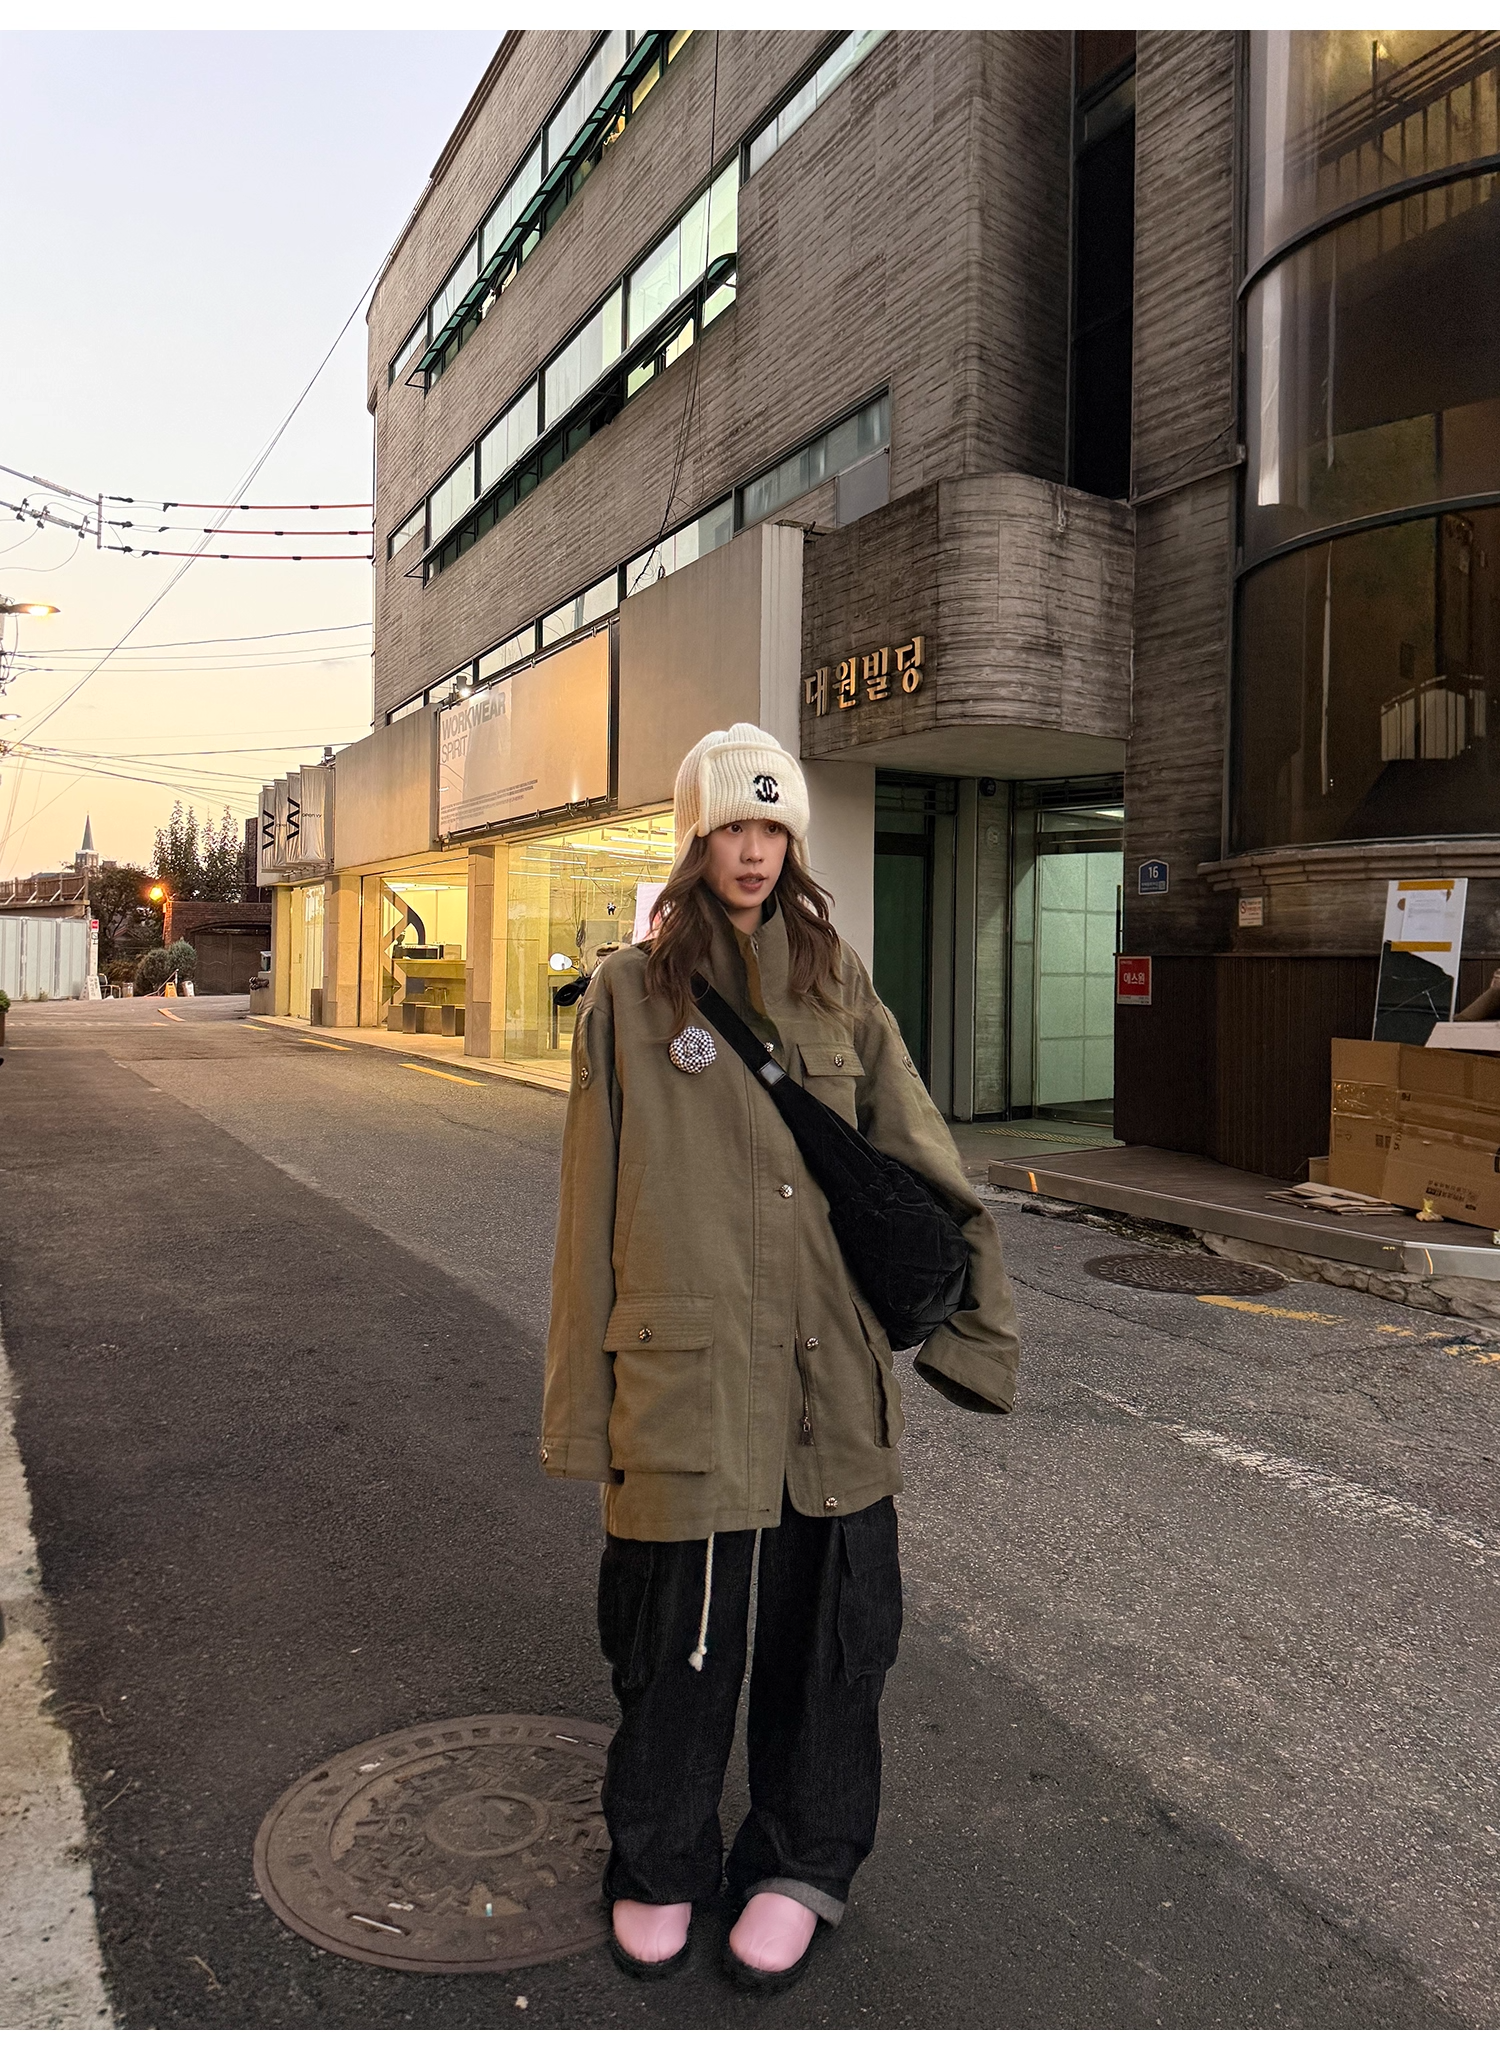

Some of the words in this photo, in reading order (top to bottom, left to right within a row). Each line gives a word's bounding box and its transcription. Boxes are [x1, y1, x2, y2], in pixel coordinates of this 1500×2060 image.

[803, 635, 926, 717] 대원빌딩
[442, 692, 506, 741] WORKWEAR
[441, 734, 468, 763] SPIRIT
[1148, 865, 1159, 879] 16
